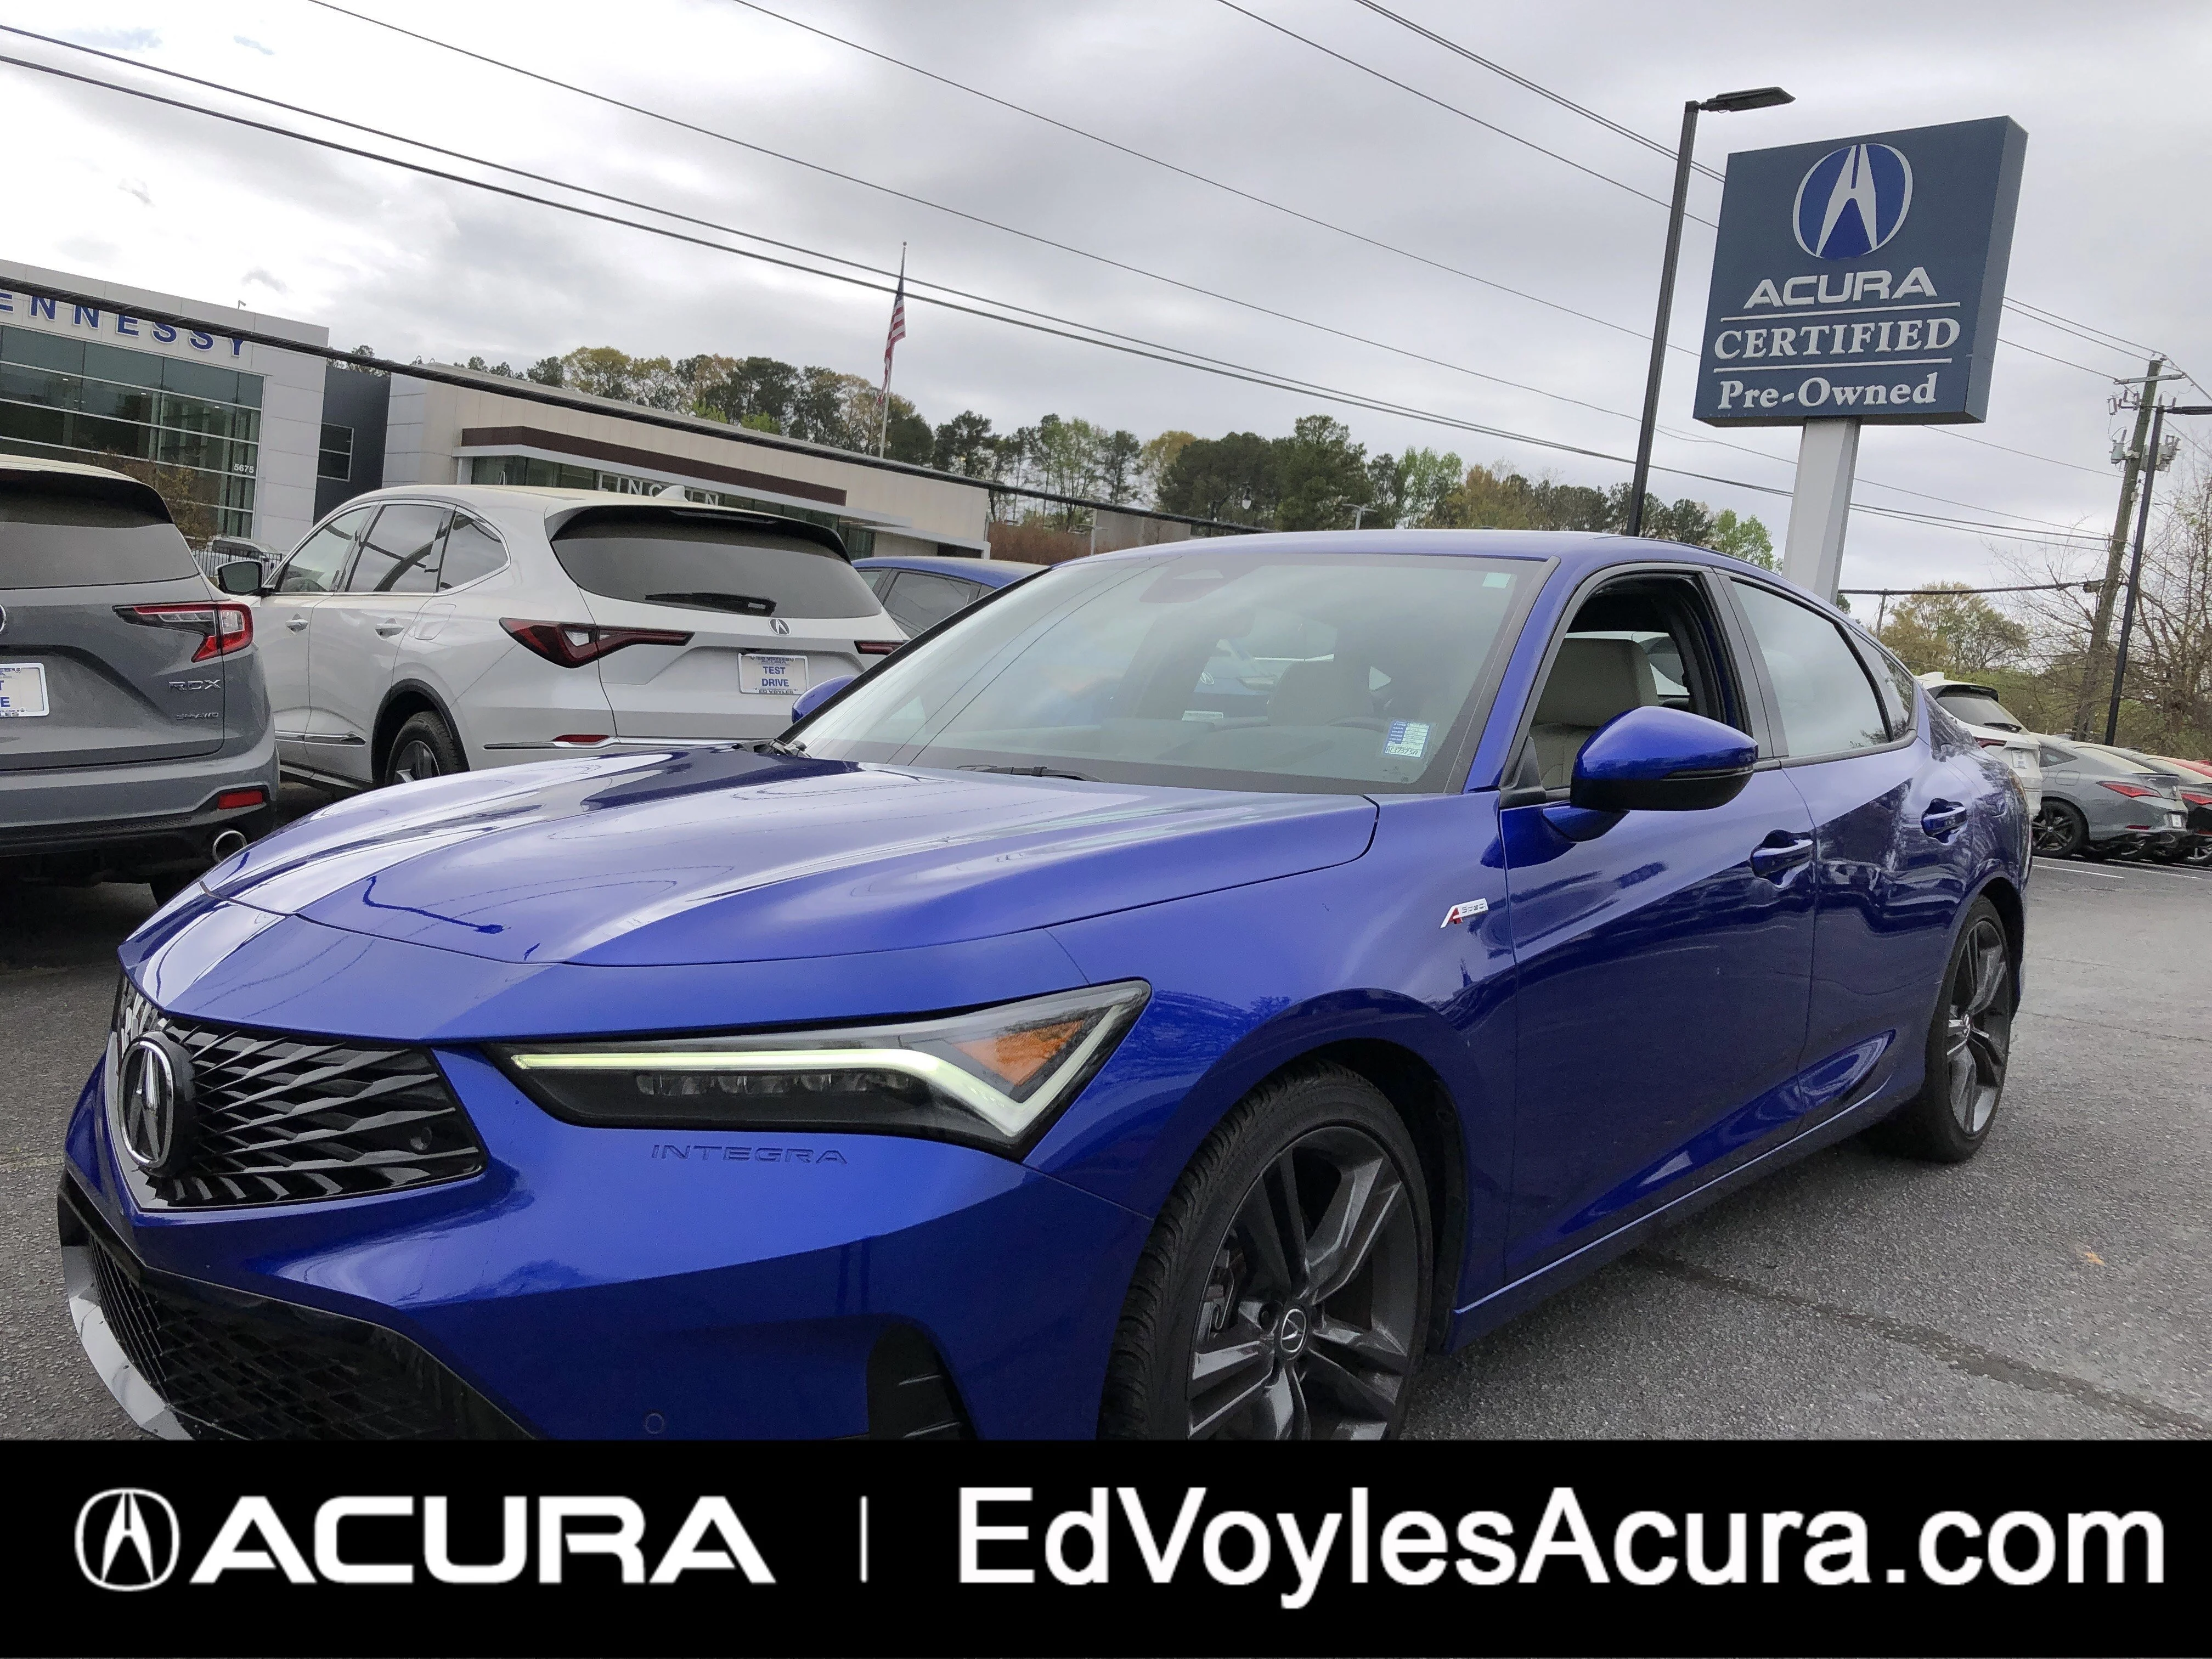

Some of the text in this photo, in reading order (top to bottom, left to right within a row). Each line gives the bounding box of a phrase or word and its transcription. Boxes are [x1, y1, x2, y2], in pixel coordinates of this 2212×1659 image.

[1743, 267, 1938, 309] ACURA
[1714, 318, 1960, 359] CERTIFIED
[1718, 371, 1938, 409] Pre-Owned
[234, 463, 255, 473] 5675
[762, 666, 786, 675] TEST
[168, 679, 221, 691] RDX
[761, 678, 789, 687] DRIVE
[651, 1144, 848, 1165] INTEGRA
